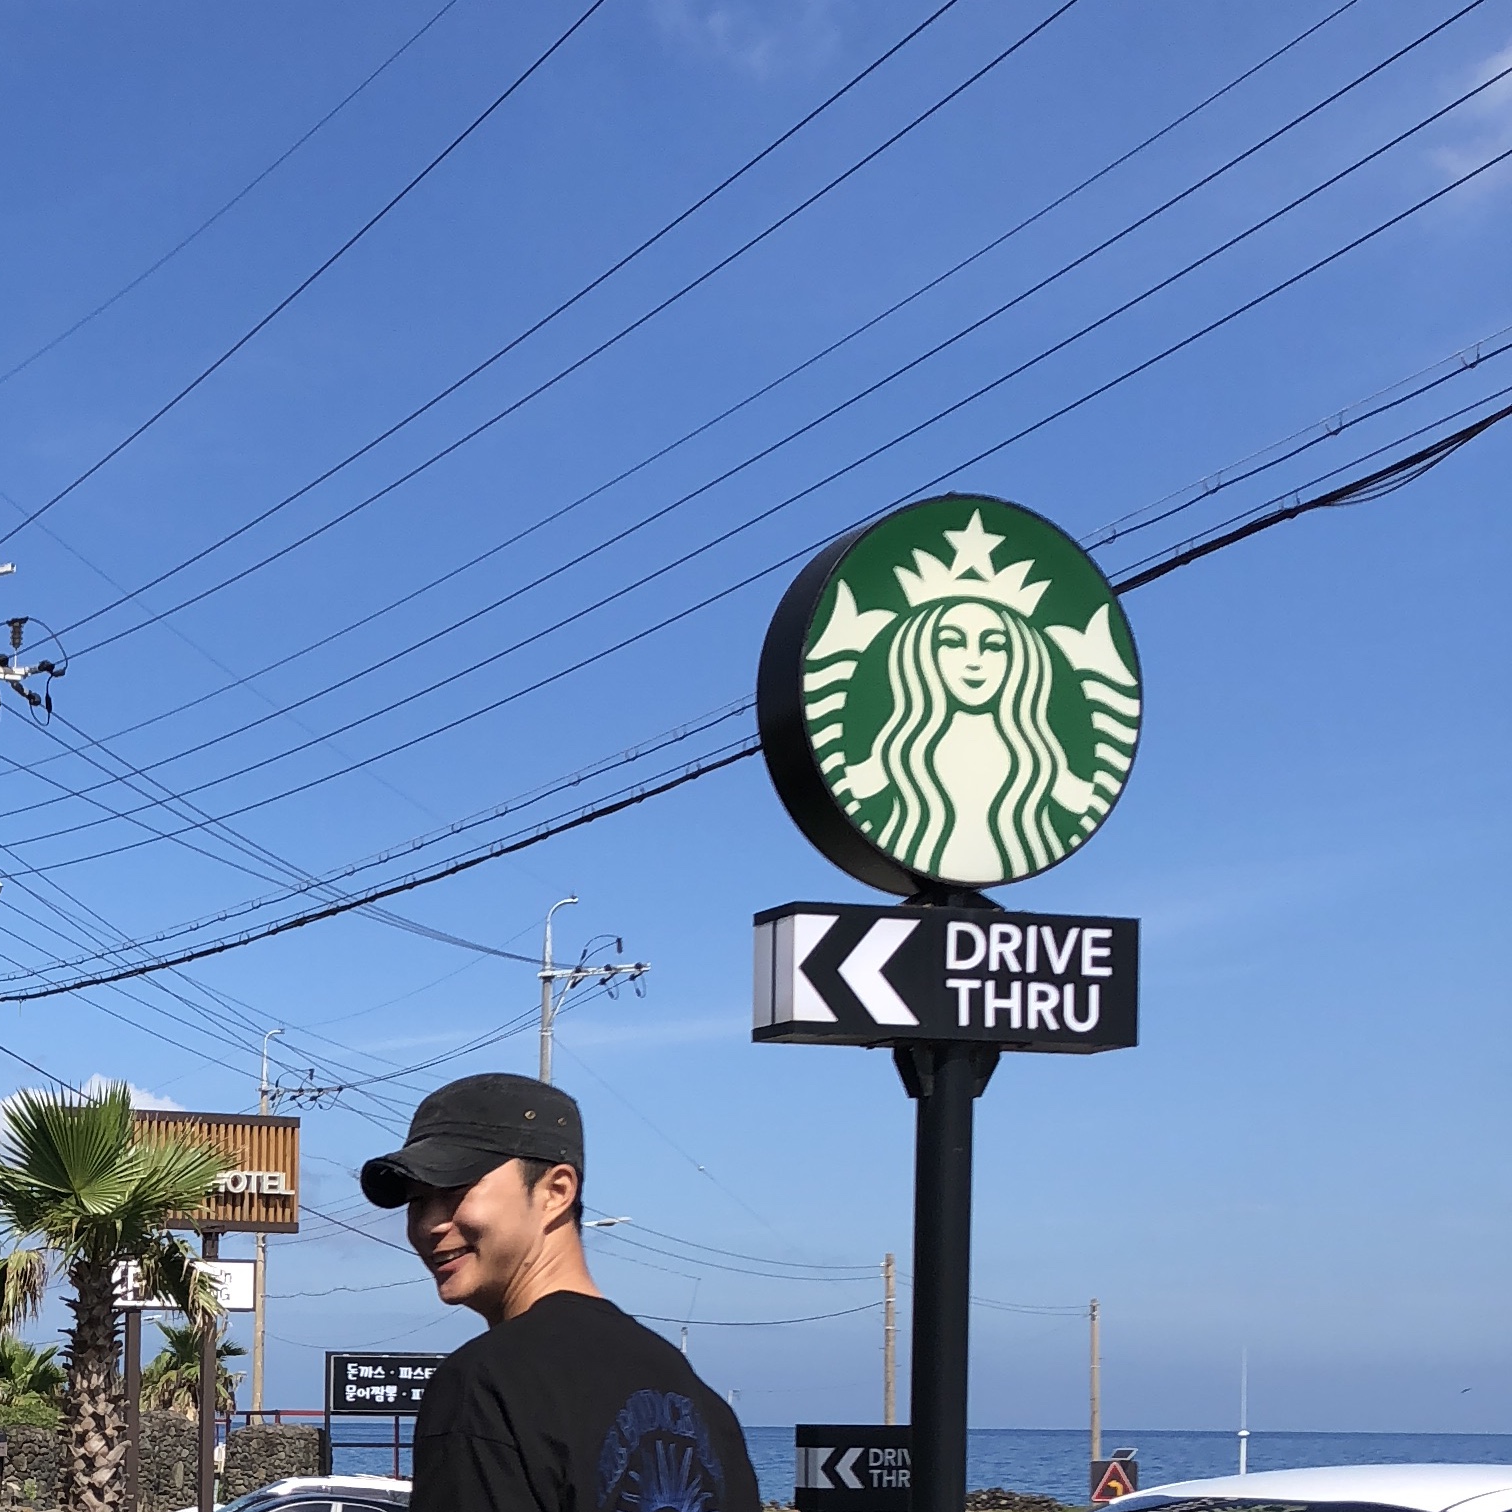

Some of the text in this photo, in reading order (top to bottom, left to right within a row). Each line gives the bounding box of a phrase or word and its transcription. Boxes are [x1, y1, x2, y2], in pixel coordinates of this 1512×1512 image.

[945, 920, 1113, 977] DRIVE
[945, 977, 1100, 1033] THRU
[346, 1363, 385, 1380] 돈까스
[345, 1384, 398, 1402] 문어짬뽕
[868, 1448, 912, 1467] DRIV
[868, 1469, 911, 1488] THR
